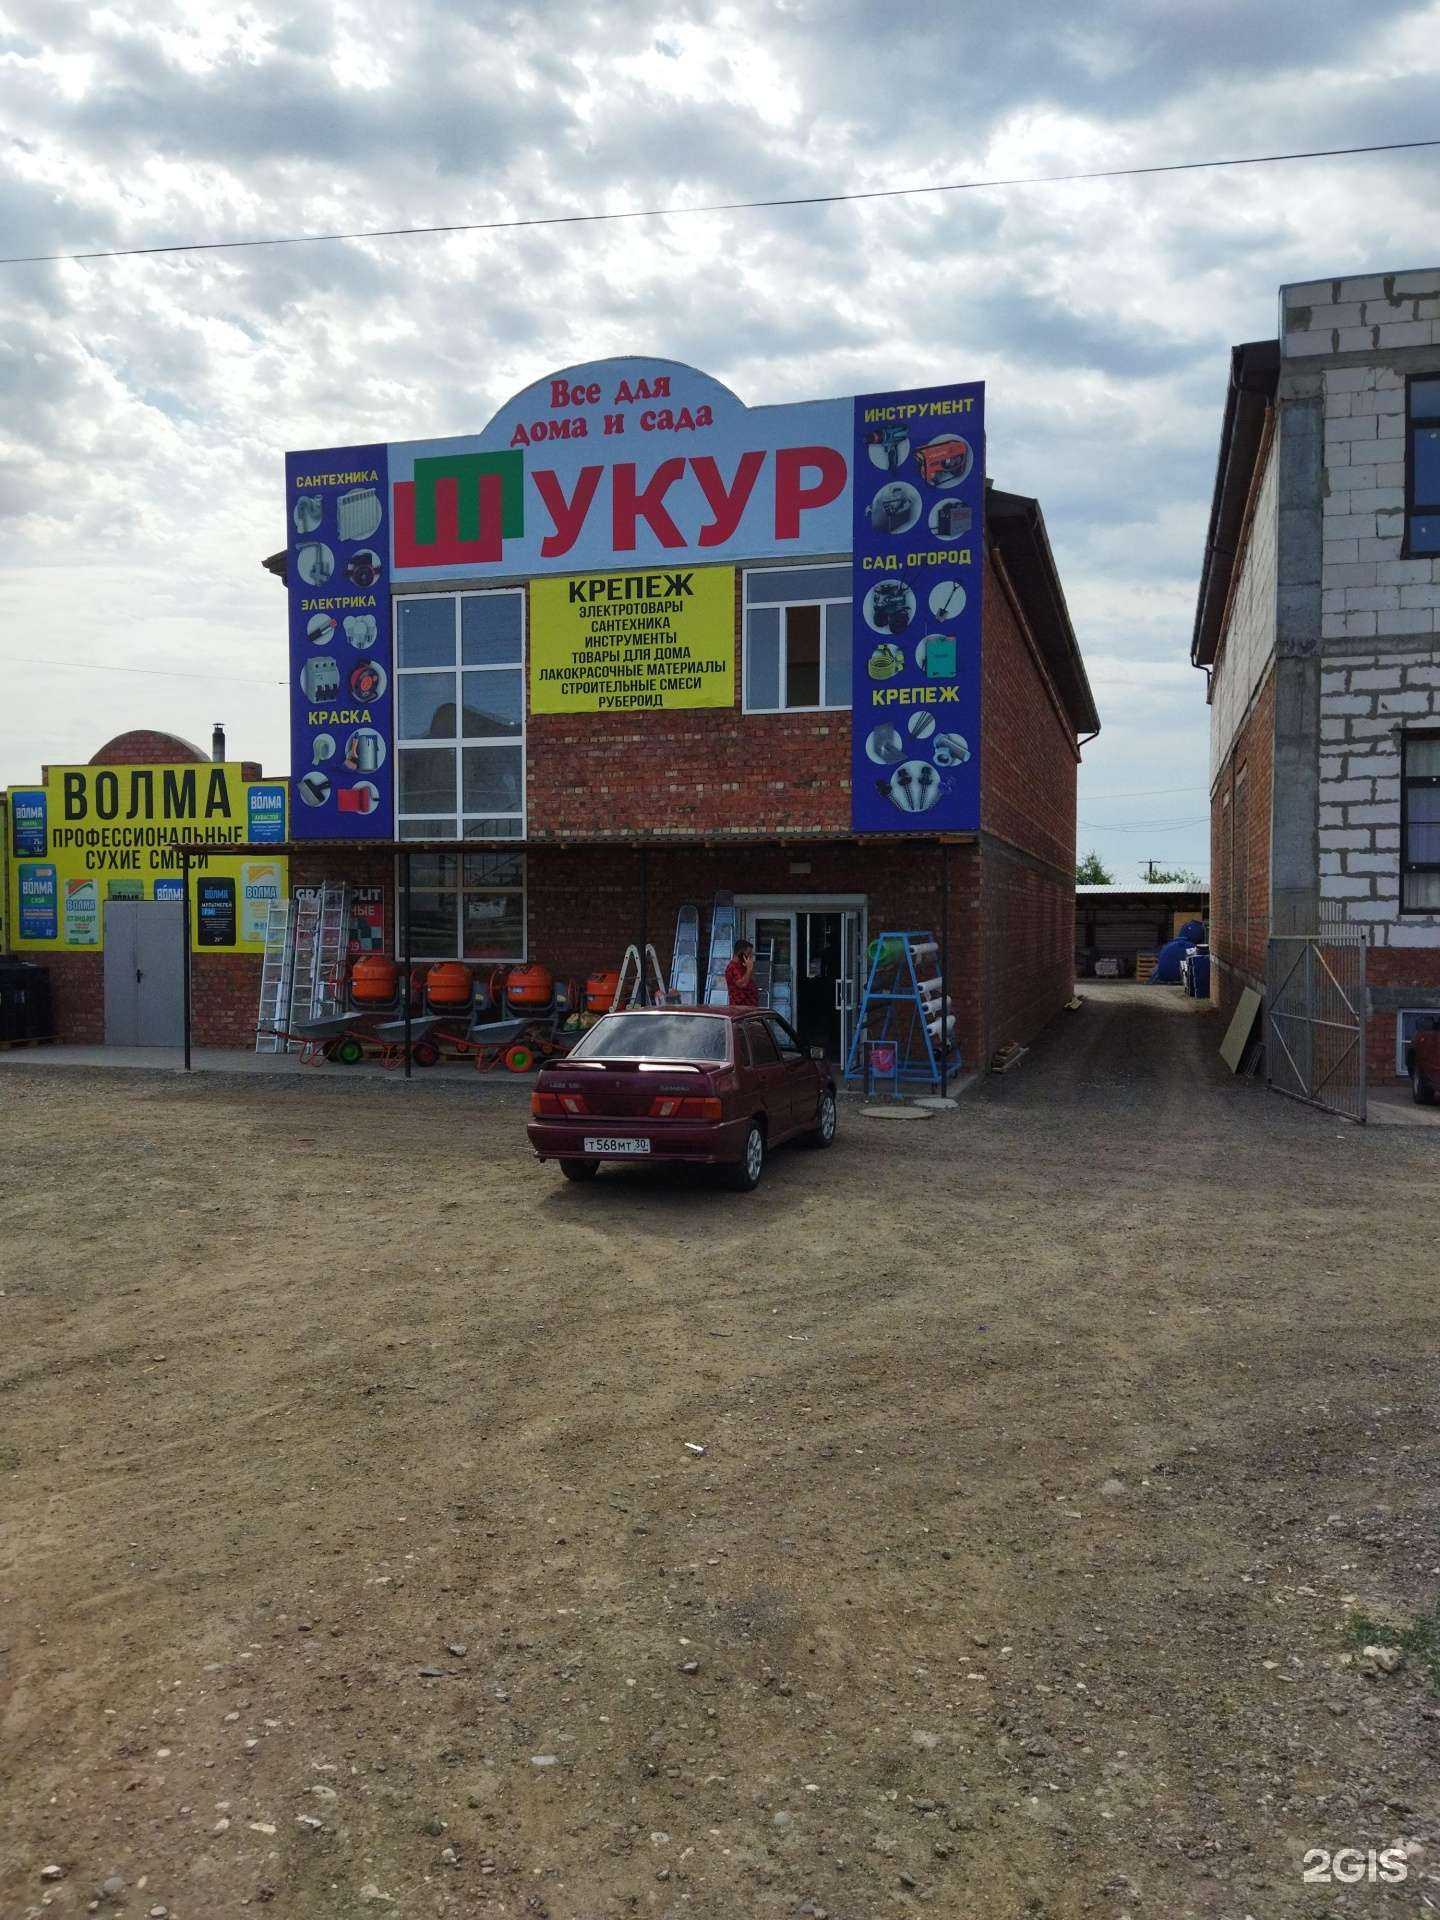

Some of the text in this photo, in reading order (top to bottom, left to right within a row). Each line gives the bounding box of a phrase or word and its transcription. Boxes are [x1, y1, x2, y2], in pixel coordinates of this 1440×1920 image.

[550, 376, 671, 408] Все для
[864, 398, 975, 422] ИНСТРУМЕНТ
[510, 404, 714, 448] дома и сада
[296, 470, 379, 488] САНТЕХНИКА
[394, 446, 848, 568] ШУКУР
[863, 549, 971, 570] САД, ОГОРОД
[569, 573, 695, 603] КРЕПЕЖ
[301, 595, 376, 611] ЭЛЕКТРИКА
[579, 600, 683, 618] ЭЛЕКТРОТОВАРЫ
[591, 617, 670, 633] САНТЕХНИКА
[585, 632, 677, 648] ИНСТРУМЕНТЫ
[572, 647, 691, 664] ТОВАРЫ ДЛЯ ДОМА
[539, 661, 726, 681] ЛАКОКРАСОЧНЫЕ МАТЕРИАЛЫ
[561, 677, 702, 695] СТРОИТЕЛЬНЫЕ СМЕСИ
[598, 694, 663, 708] РУБЕРОИД
[872, 686, 960, 706] КРЕПЕЖ
[308, 709, 372, 725] КРАСКА
[64, 768, 232, 820] ВОЛМА
[52, 826, 243, 848] ПРОФЕССИОНАЛЬНЫЕ
[86, 850, 141, 869] СУХИЕ
